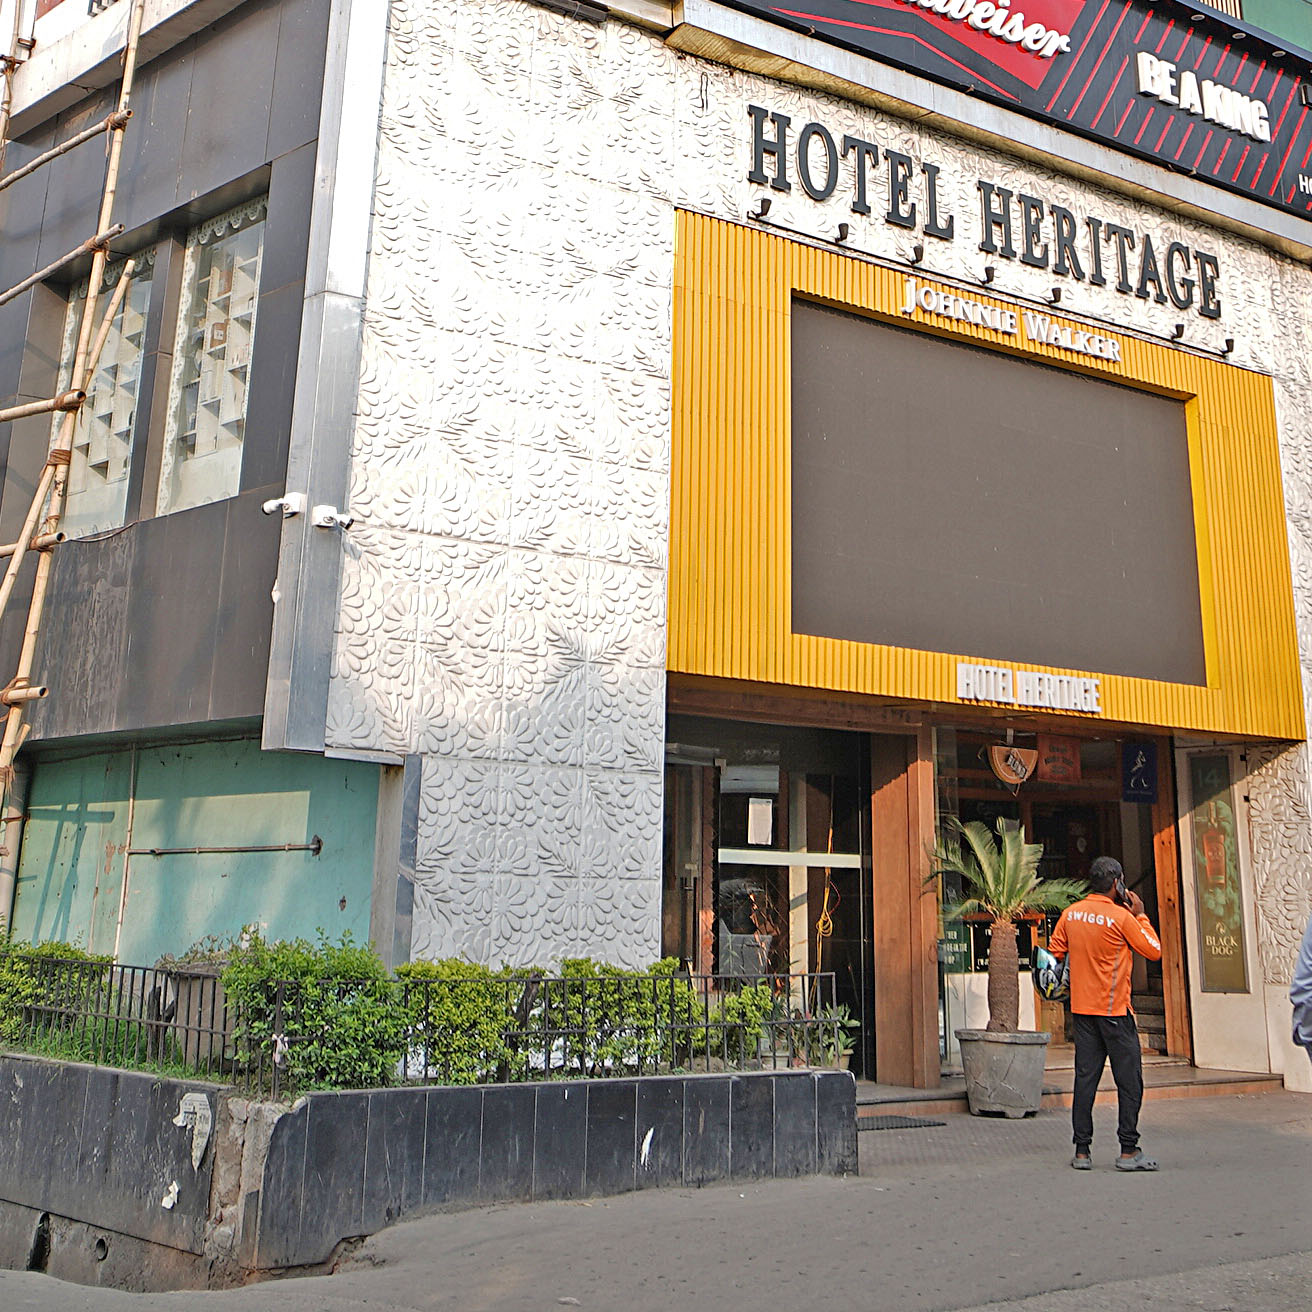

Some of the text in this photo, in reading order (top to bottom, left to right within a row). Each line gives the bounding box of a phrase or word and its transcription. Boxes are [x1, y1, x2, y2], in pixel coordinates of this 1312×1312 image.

[1137, 51, 1272, 143] BE A KING
[747, 104, 1222, 320] HOTEL HERITAGE
[901, 278, 1122, 363] JOHNNIE WALKER
[957, 662, 1103, 714] HOTEL HERITAGE
[1066, 910, 1115, 928] SWIGGY
[1205, 935, 1238, 947] BLACK
[1211, 946, 1234, 956] DOG
